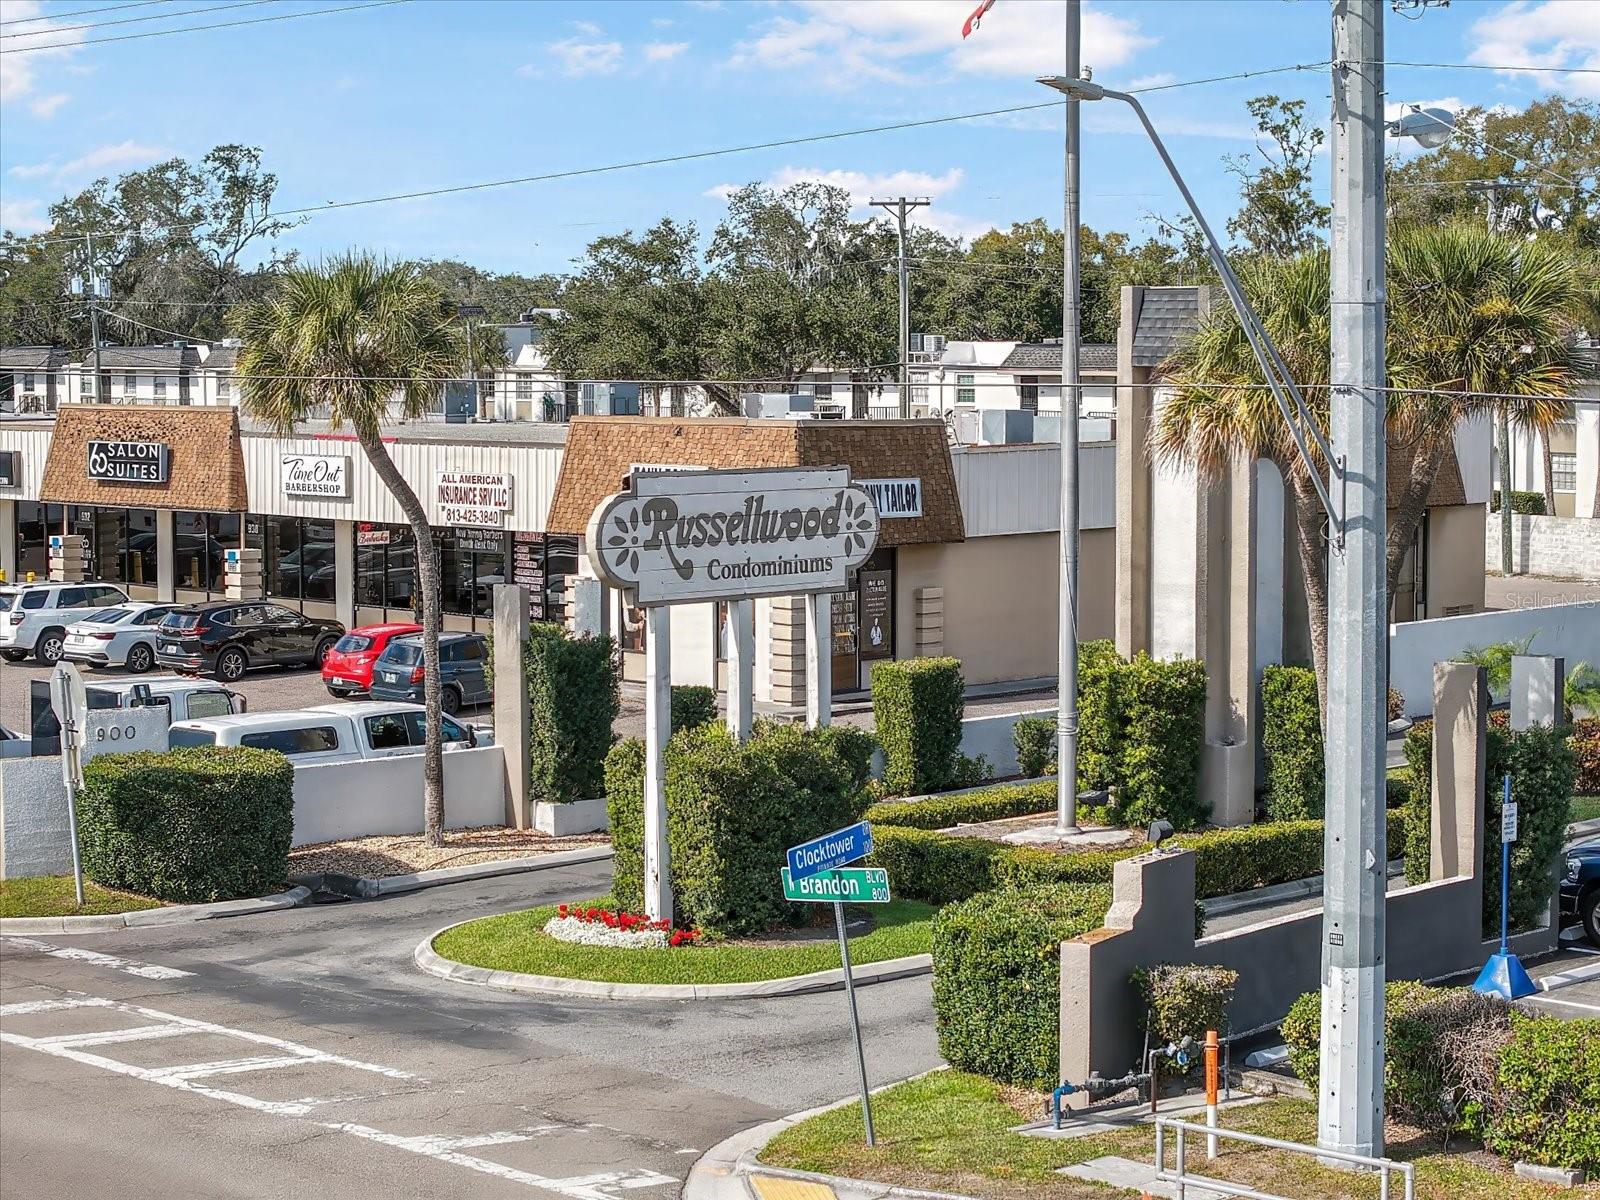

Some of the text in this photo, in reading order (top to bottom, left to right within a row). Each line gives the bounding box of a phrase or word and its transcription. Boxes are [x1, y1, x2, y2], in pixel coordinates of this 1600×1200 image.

[107, 442, 159, 458] SALON
[107, 463, 157, 479] SUITES
[283, 457, 343, 482] Time Out
[285, 482, 341, 493] BARBERSHOP
[441, 474, 503, 486] ALL AMERICAN
[438, 485, 507, 507] INSURANCE SRV LLC
[885, 484, 918, 512] TAILOR
[446, 508, 499, 524] 813-425-3840
[641, 489, 845, 581] Russellwood
[707, 554, 834, 581] Condominiums
[96, 726, 136, 742] 900
[795, 835, 855, 869] Clocktower
[800, 875, 860, 895] Brandon
[865, 870, 885, 884] BLVD
[872, 887, 887, 900] 800
